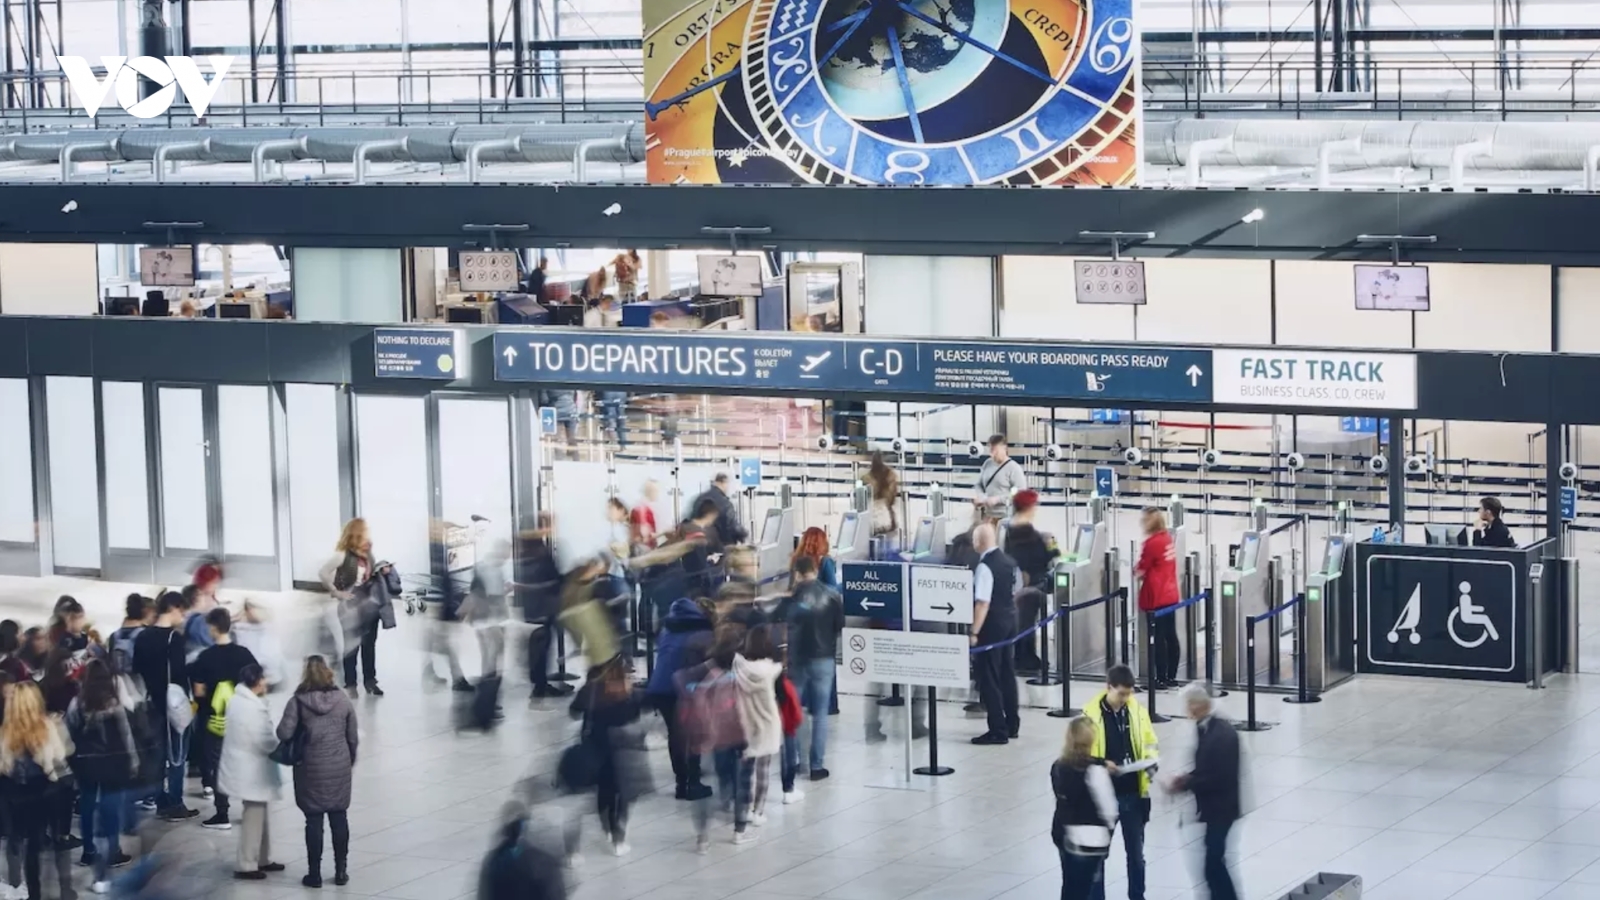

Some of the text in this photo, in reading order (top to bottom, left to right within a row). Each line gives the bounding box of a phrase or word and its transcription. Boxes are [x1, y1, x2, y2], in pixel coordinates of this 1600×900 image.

[677, 41, 741, 113] ARORA
[377, 336, 451, 346] NOTHING TO DECLARE
[529, 343, 746, 376] TO DEPARTURES
[754, 349, 760, 357] K
[934, 349, 1169, 368] PLEASE HAVE YOUR BOARDING PASS READY
[860, 348, 903, 375] C-D
[1240, 358, 1384, 382] FAST TRACK
[1240, 385, 1293, 397] BUSINESS
[1354, 388, 1386, 400] CREW
[864, 570, 879, 580] ALL
[845, 581, 898, 592] PASSENGERS
[917, 579, 967, 591] FAST TRACK
